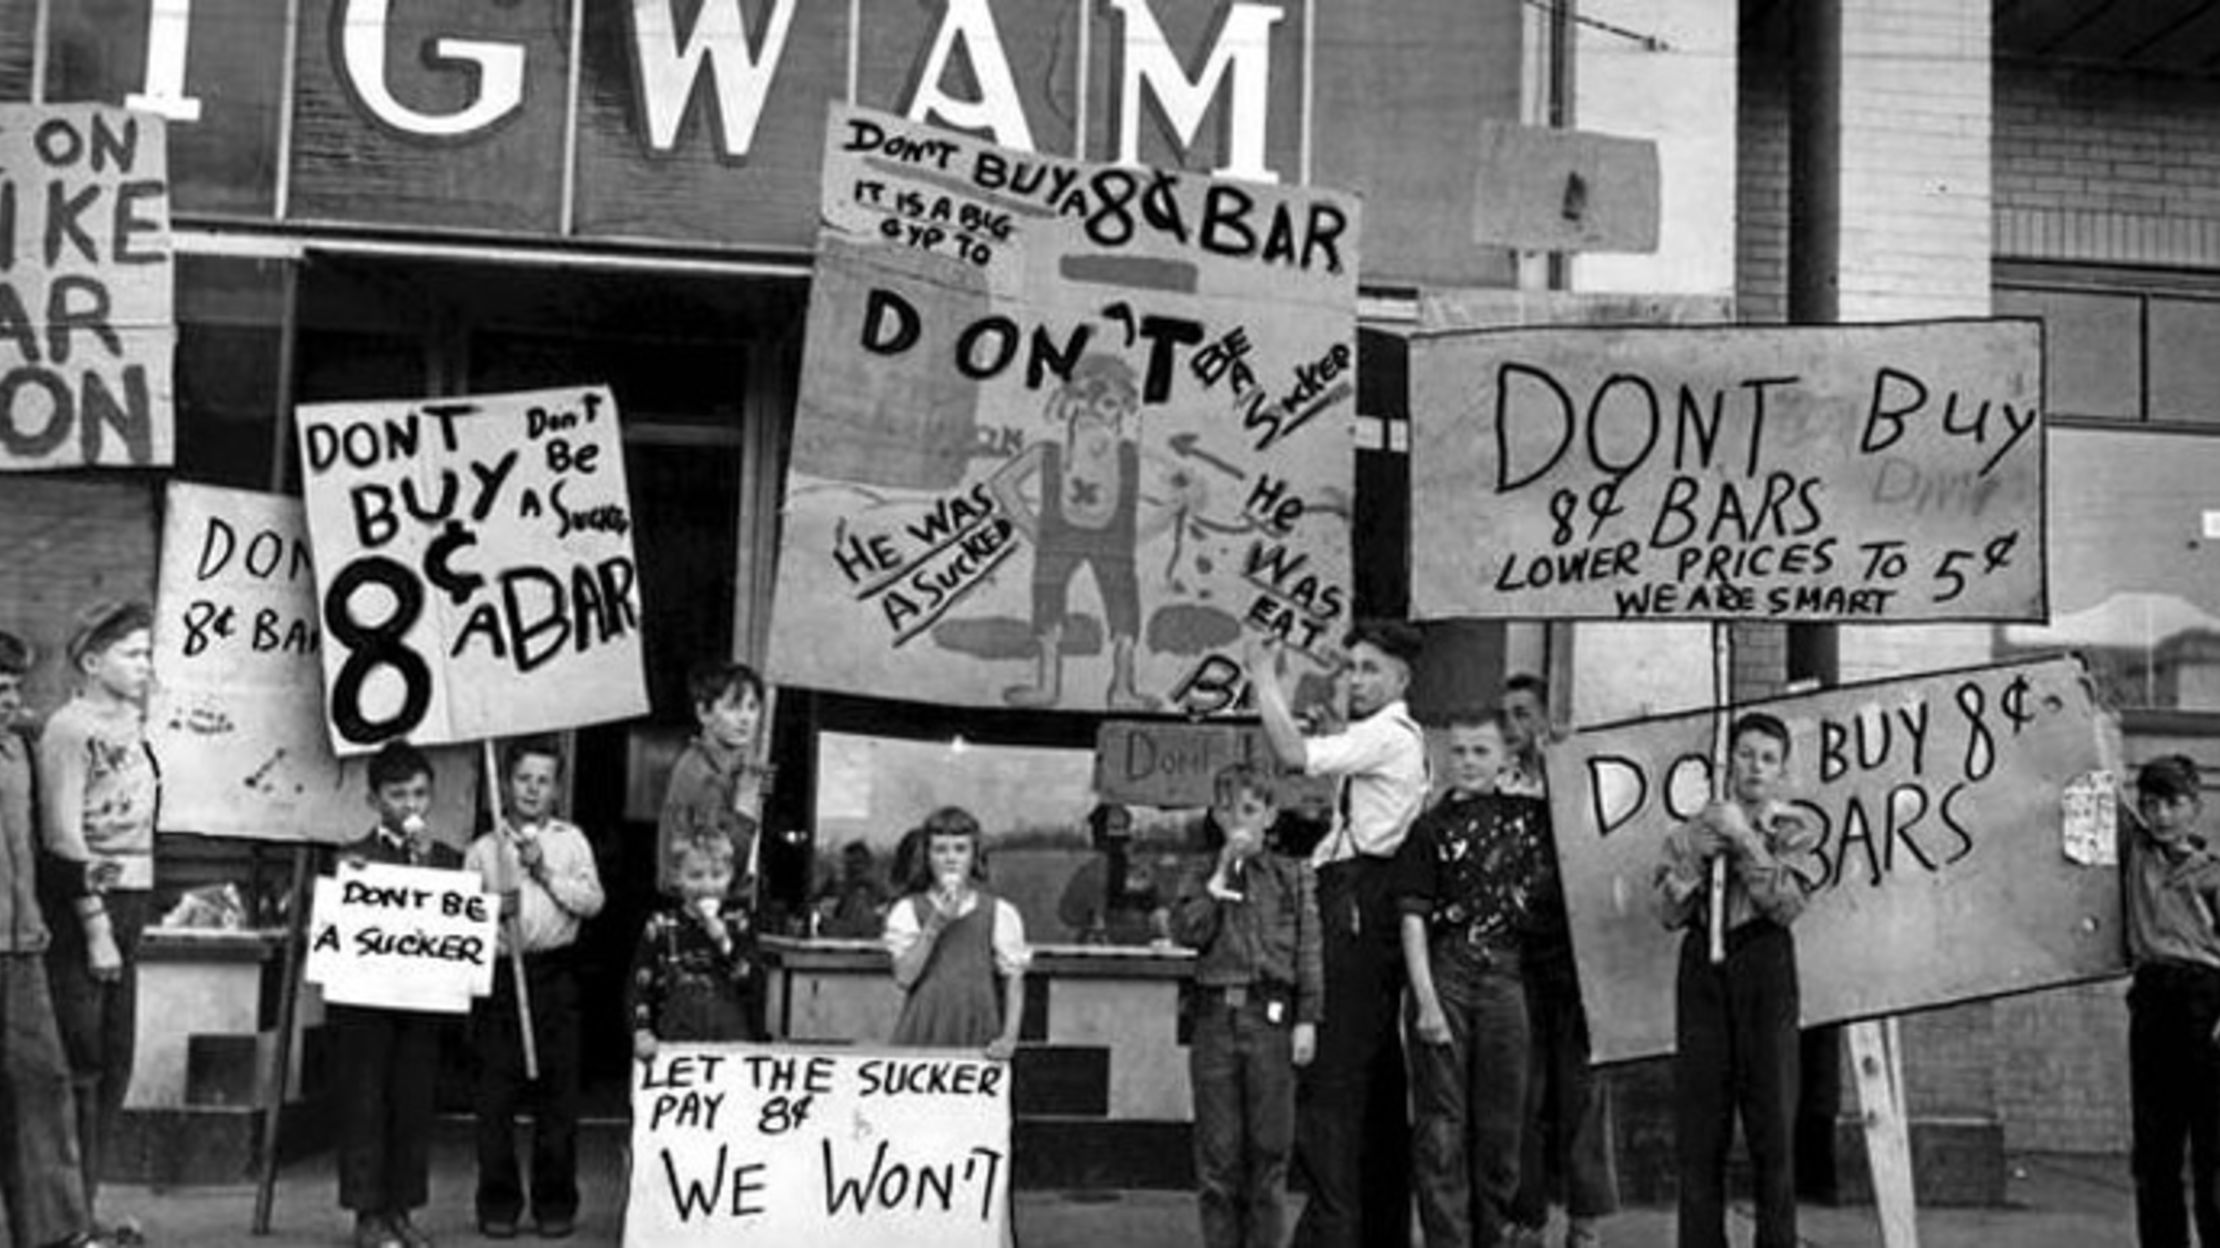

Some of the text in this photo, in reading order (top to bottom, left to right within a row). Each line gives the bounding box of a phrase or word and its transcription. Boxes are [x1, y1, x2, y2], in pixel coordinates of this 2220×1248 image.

[34, 112, 138, 174] ON
[854, 180, 1014, 242] IT IS A BIG
[880, 218, 993, 267] GYP TO
[973, 151, 1079, 205] BUY
[1059, 188, 1089, 218] A
[1200, 185, 1348, 274] BAR
[861, 289, 1204, 404] DON'T
[1190, 326, 1252, 388] BE
[0, 364, 151, 464] ON
[306, 405, 481, 473] DONT
[1495, 362, 1800, 494] DONT
[351, 450, 518, 548] BUY
[1649, 471, 1823, 550] BARS
[198, 516, 315, 582] DON
[833, 482, 994, 584] HE WAS
[1495, 539, 1641, 590] LOWER
[1677, 536, 1838, 583] PRICES
[883, 591, 920, 631] A
[1245, 540, 1341, 620] WAS
[1614, 583, 1898, 619] WE ARE SMART
[252, 607, 322, 655] BA
[451, 557, 636, 674] A BAR
[1250, 595, 1328, 650] EAT
[1819, 701, 1930, 783] BUY
[441, 890, 489, 923] BE
[314, 925, 485, 965] A SUCKER
[641, 1056, 1002, 1097] LET THE SUCKER
[650, 1092, 726, 1131] PAY
[660, 1136, 1003, 1223] WE WON'T
